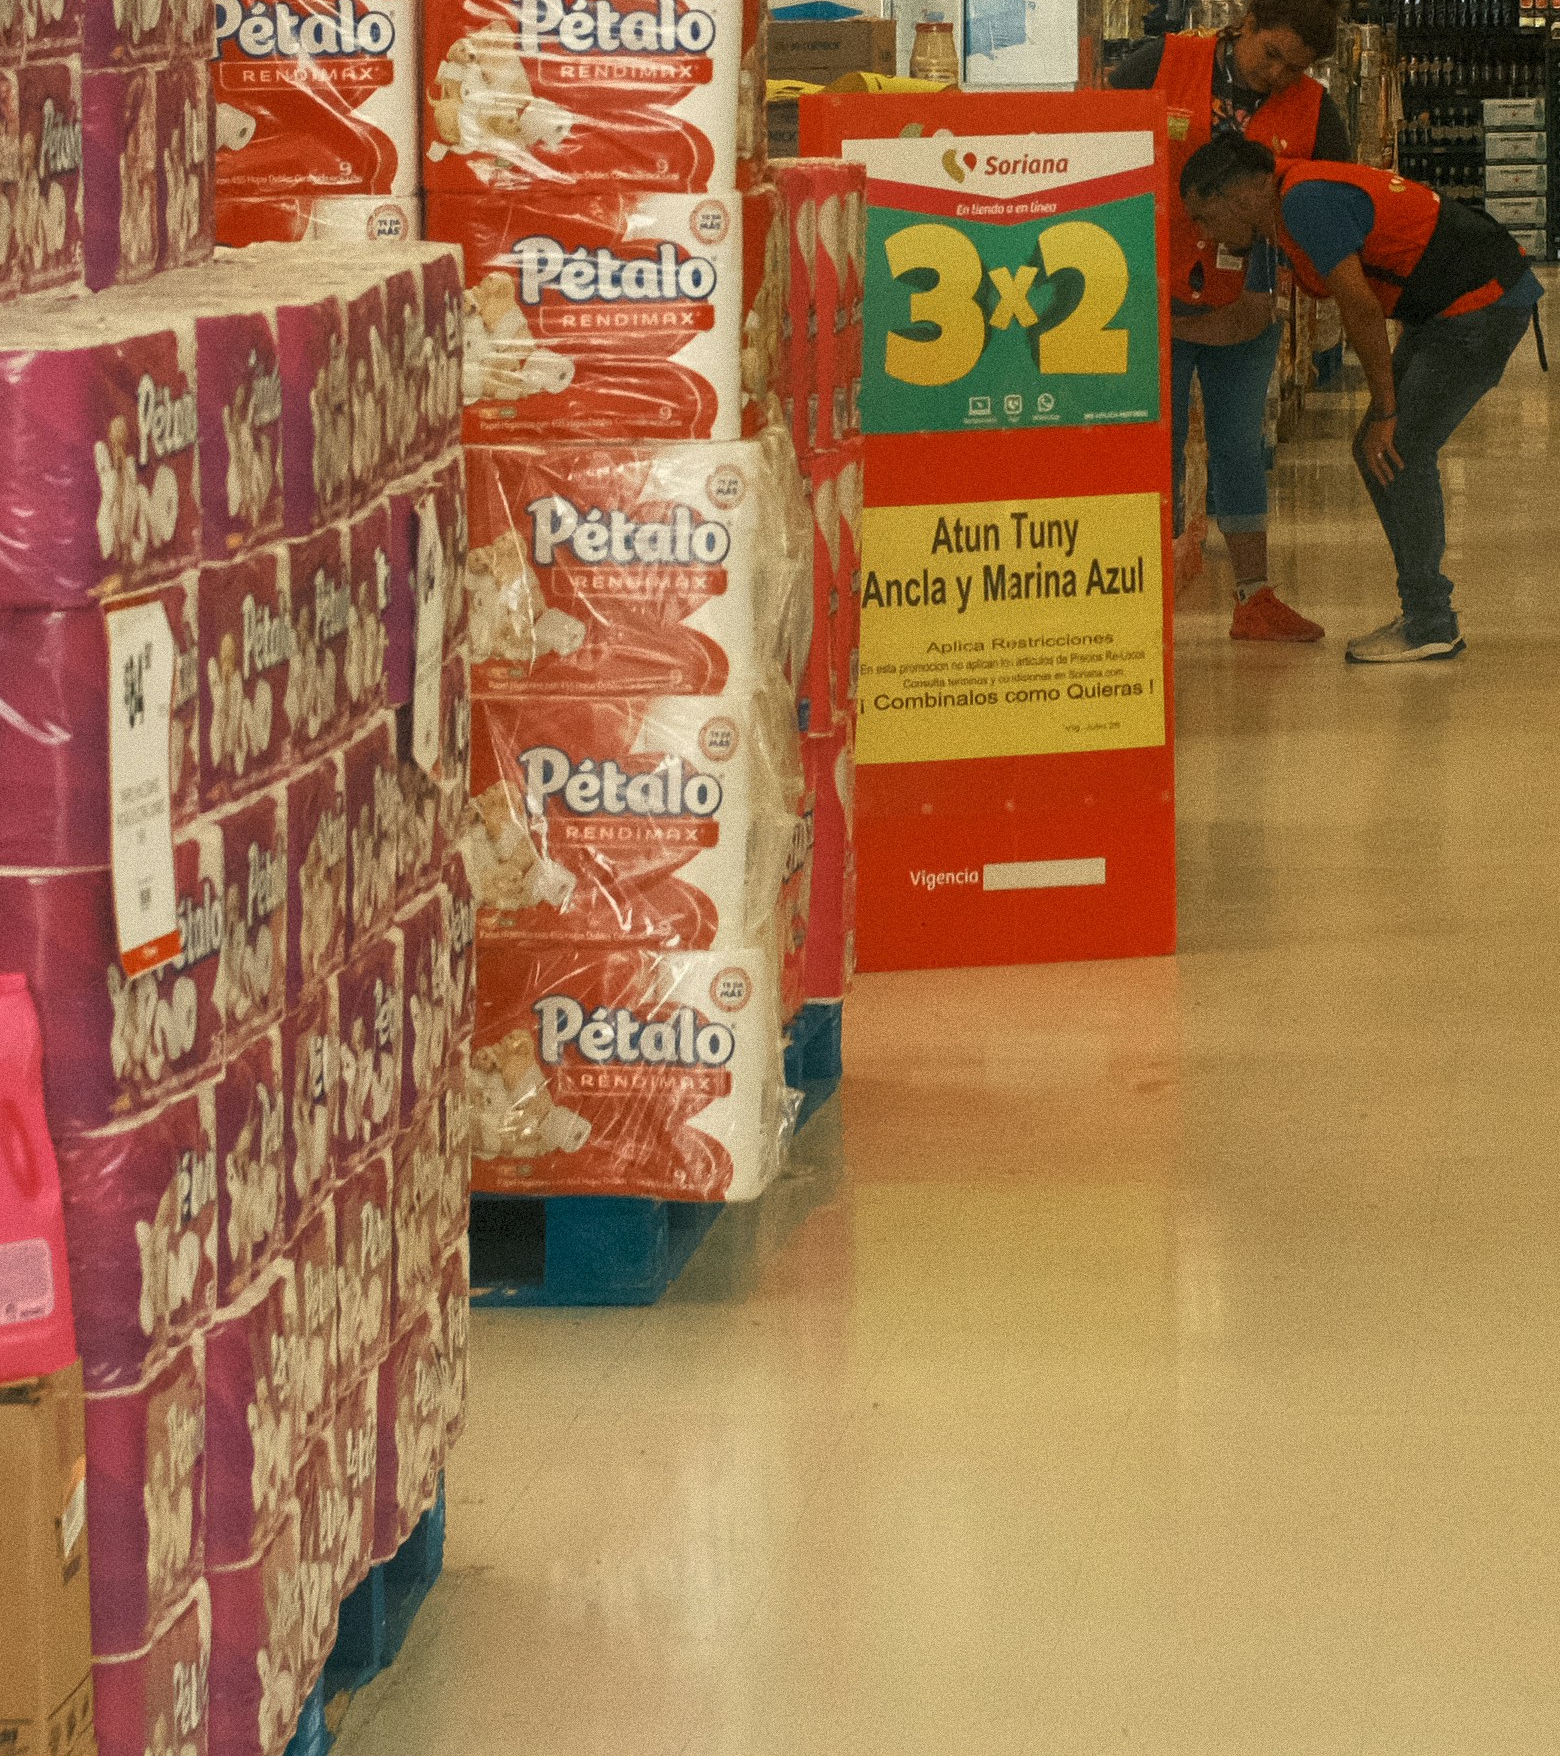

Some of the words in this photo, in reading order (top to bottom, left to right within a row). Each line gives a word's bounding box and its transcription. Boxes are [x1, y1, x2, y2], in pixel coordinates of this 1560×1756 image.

[984, 154, 1069, 176] Soriana
[956, 204, 969, 216] En
[512, 234, 716, 304] Pétalo
[883, 221, 1130, 386] 3x2
[527, 493, 730, 566] Pétalo
[931, 515, 1000, 555] Atun
[1010, 511, 1079, 556] Tuny
[861, 567, 946, 609] Ancla
[956, 575, 973, 613] y
[983, 561, 1077, 602] Marina
[1085, 557, 1144, 596] Azul
[926, 640, 985, 655] Aplica
[992, 632, 1114, 651] Restricciones
[1005, 686, 1060, 703] como
[1067, 681, 1143, 699] Quieras
[518, 745, 723, 818] Pétalo
[910, 868, 979, 890] Vigencia
[532, 994, 735, 1065] Pétalo
